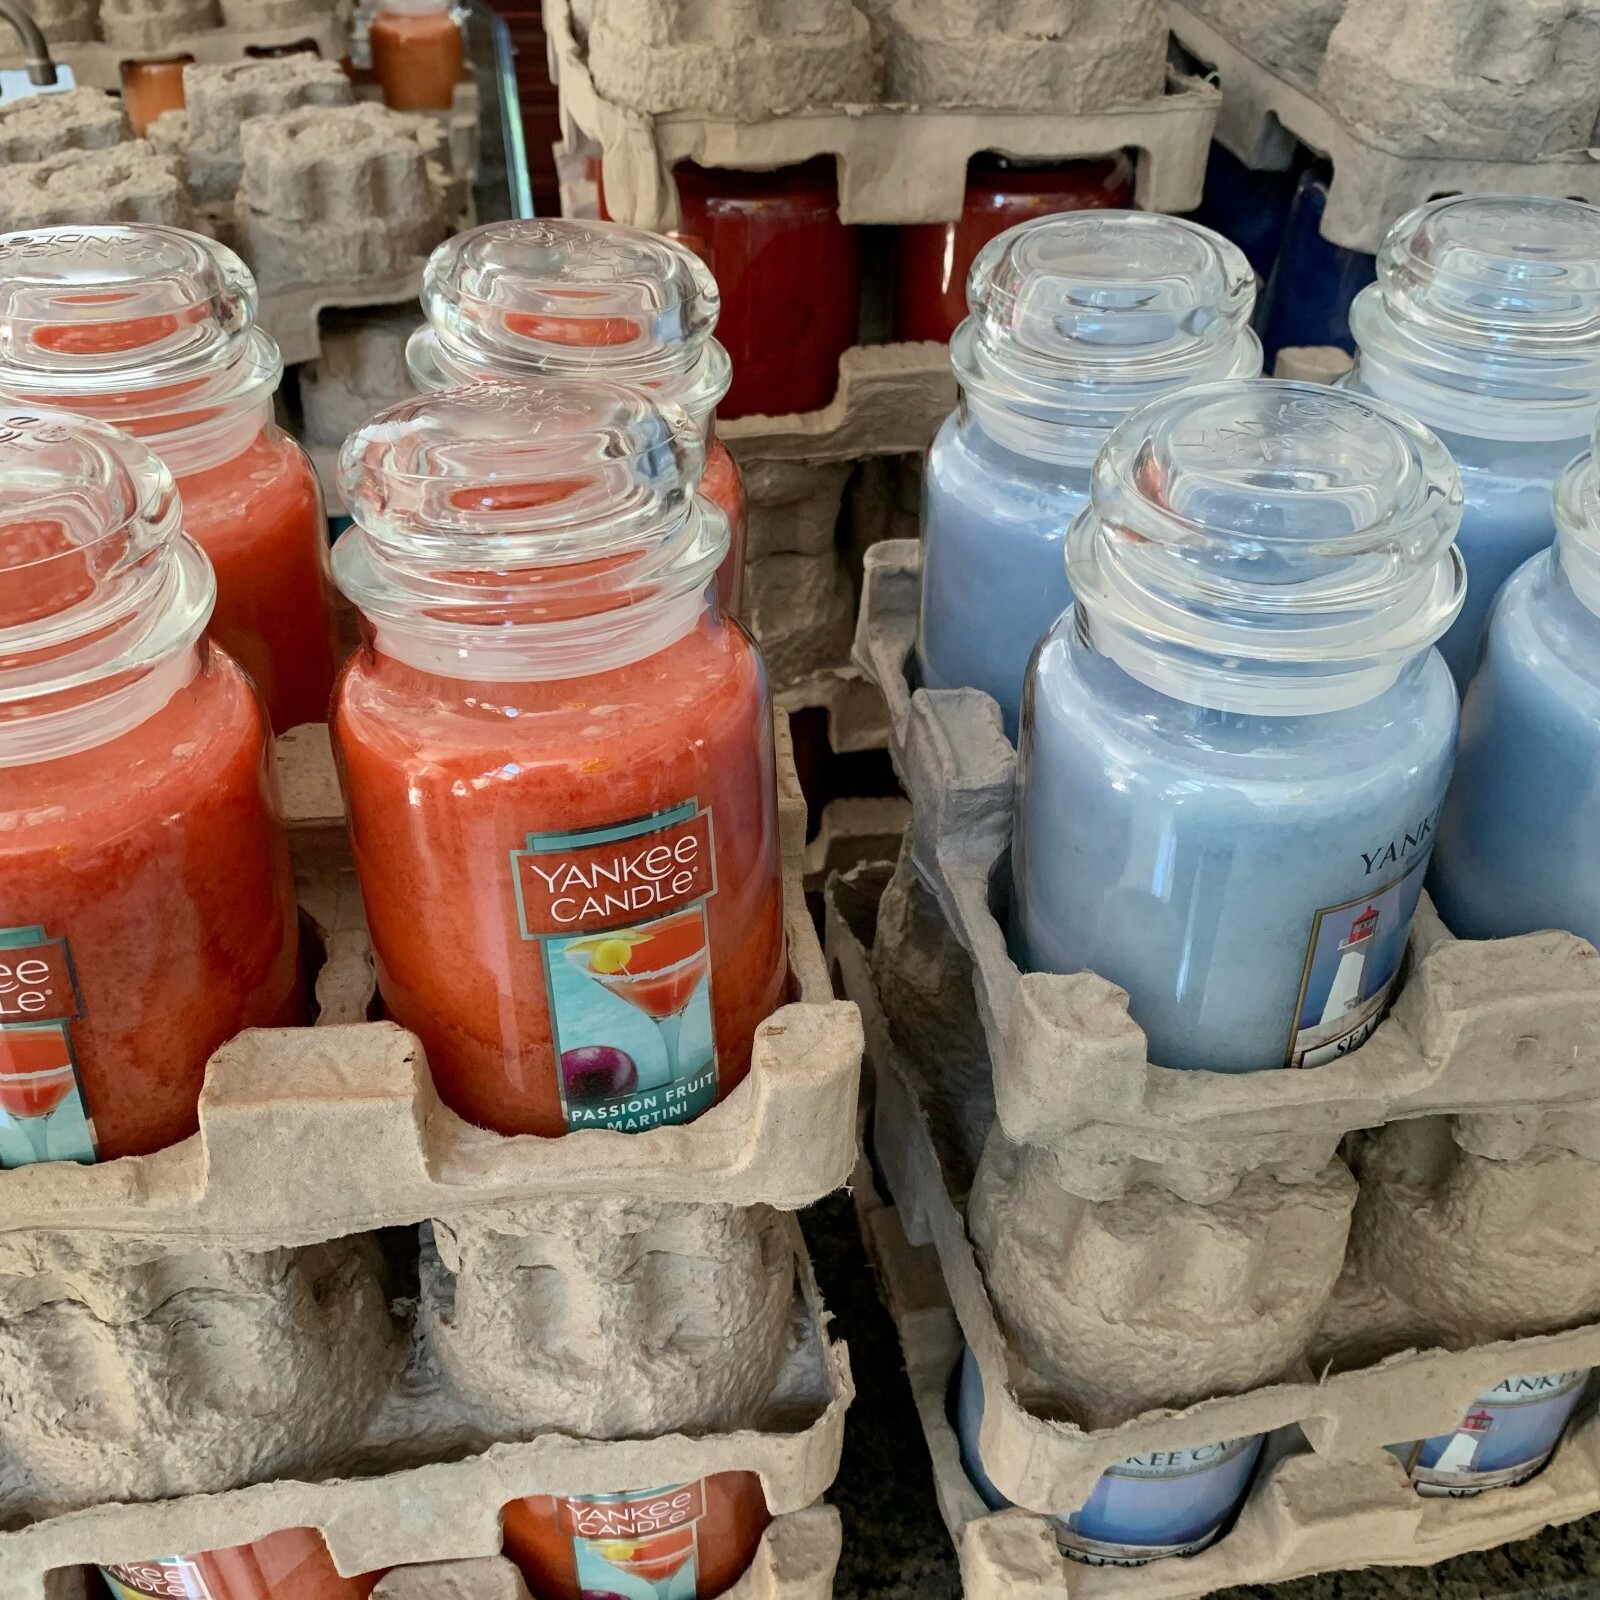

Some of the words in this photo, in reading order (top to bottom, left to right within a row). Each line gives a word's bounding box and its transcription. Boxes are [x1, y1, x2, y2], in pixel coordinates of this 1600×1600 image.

[571, 1095, 657, 1122] PASSION
[665, 1071, 714, 1102] FRUIT
[607, 1100, 688, 1132] MARTINI
